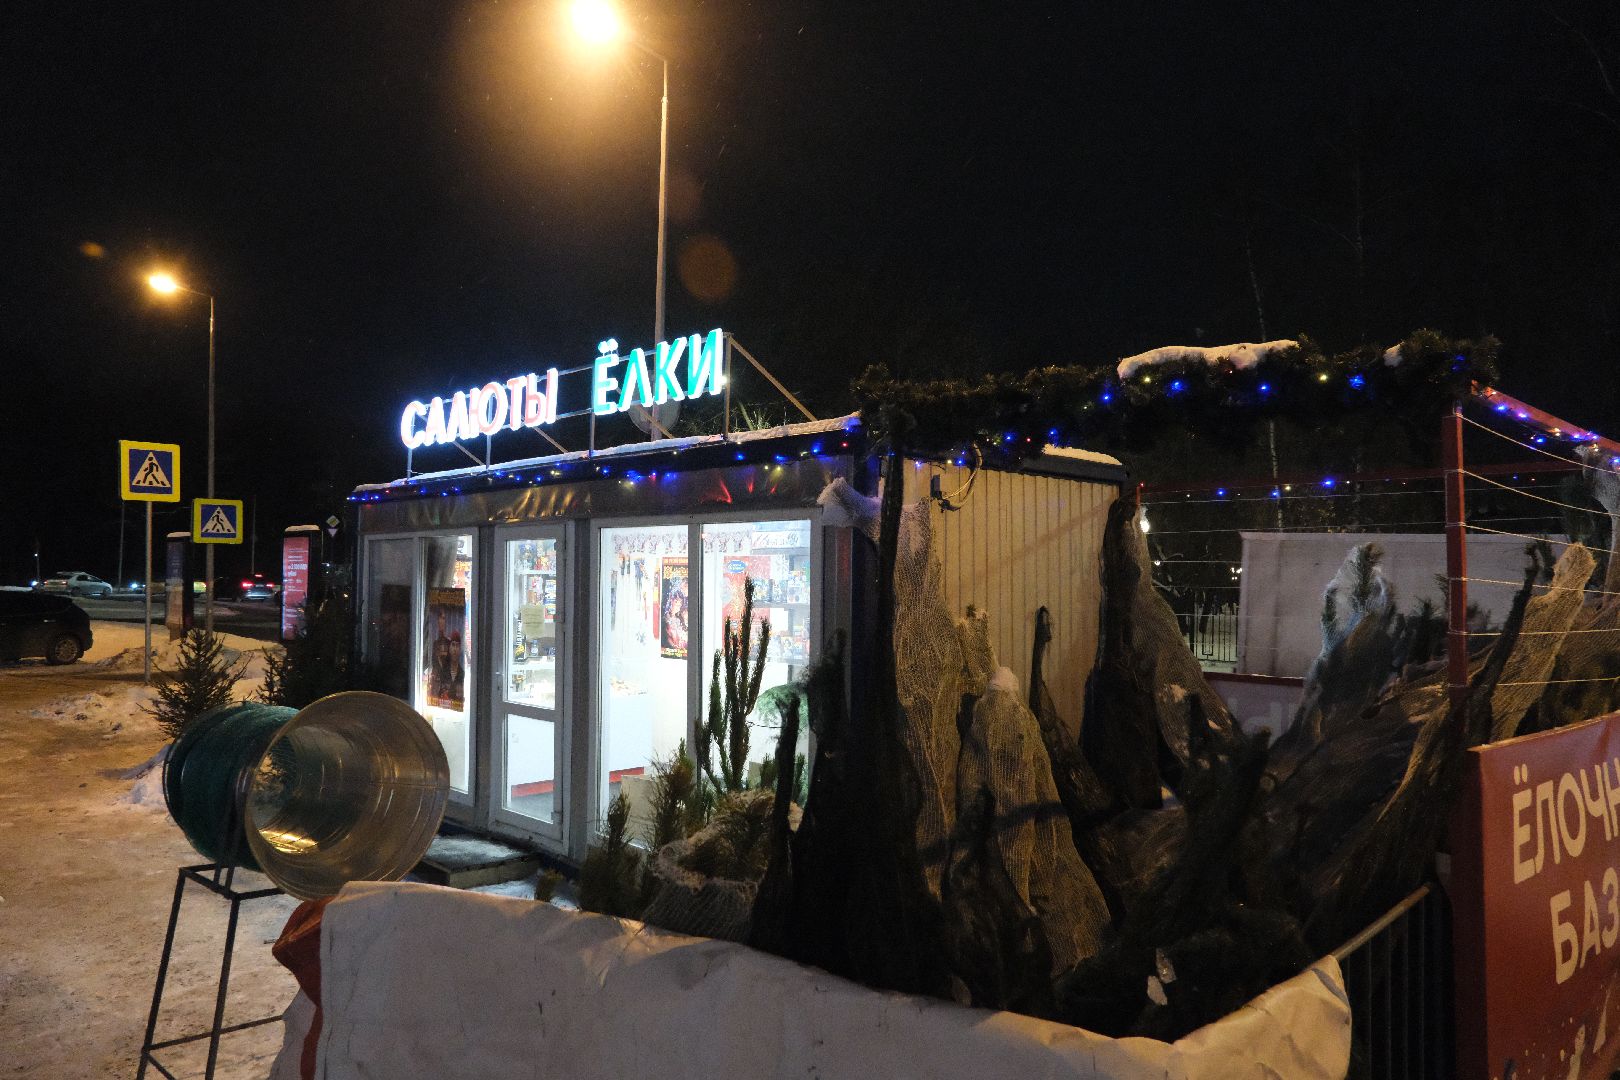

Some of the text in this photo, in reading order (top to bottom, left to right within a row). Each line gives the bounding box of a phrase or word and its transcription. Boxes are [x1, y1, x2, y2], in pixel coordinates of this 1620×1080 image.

[401, 328, 724, 448] САЛЮТЫ ЁЛКИ
[1550, 867, 1620, 984] БАЗ
